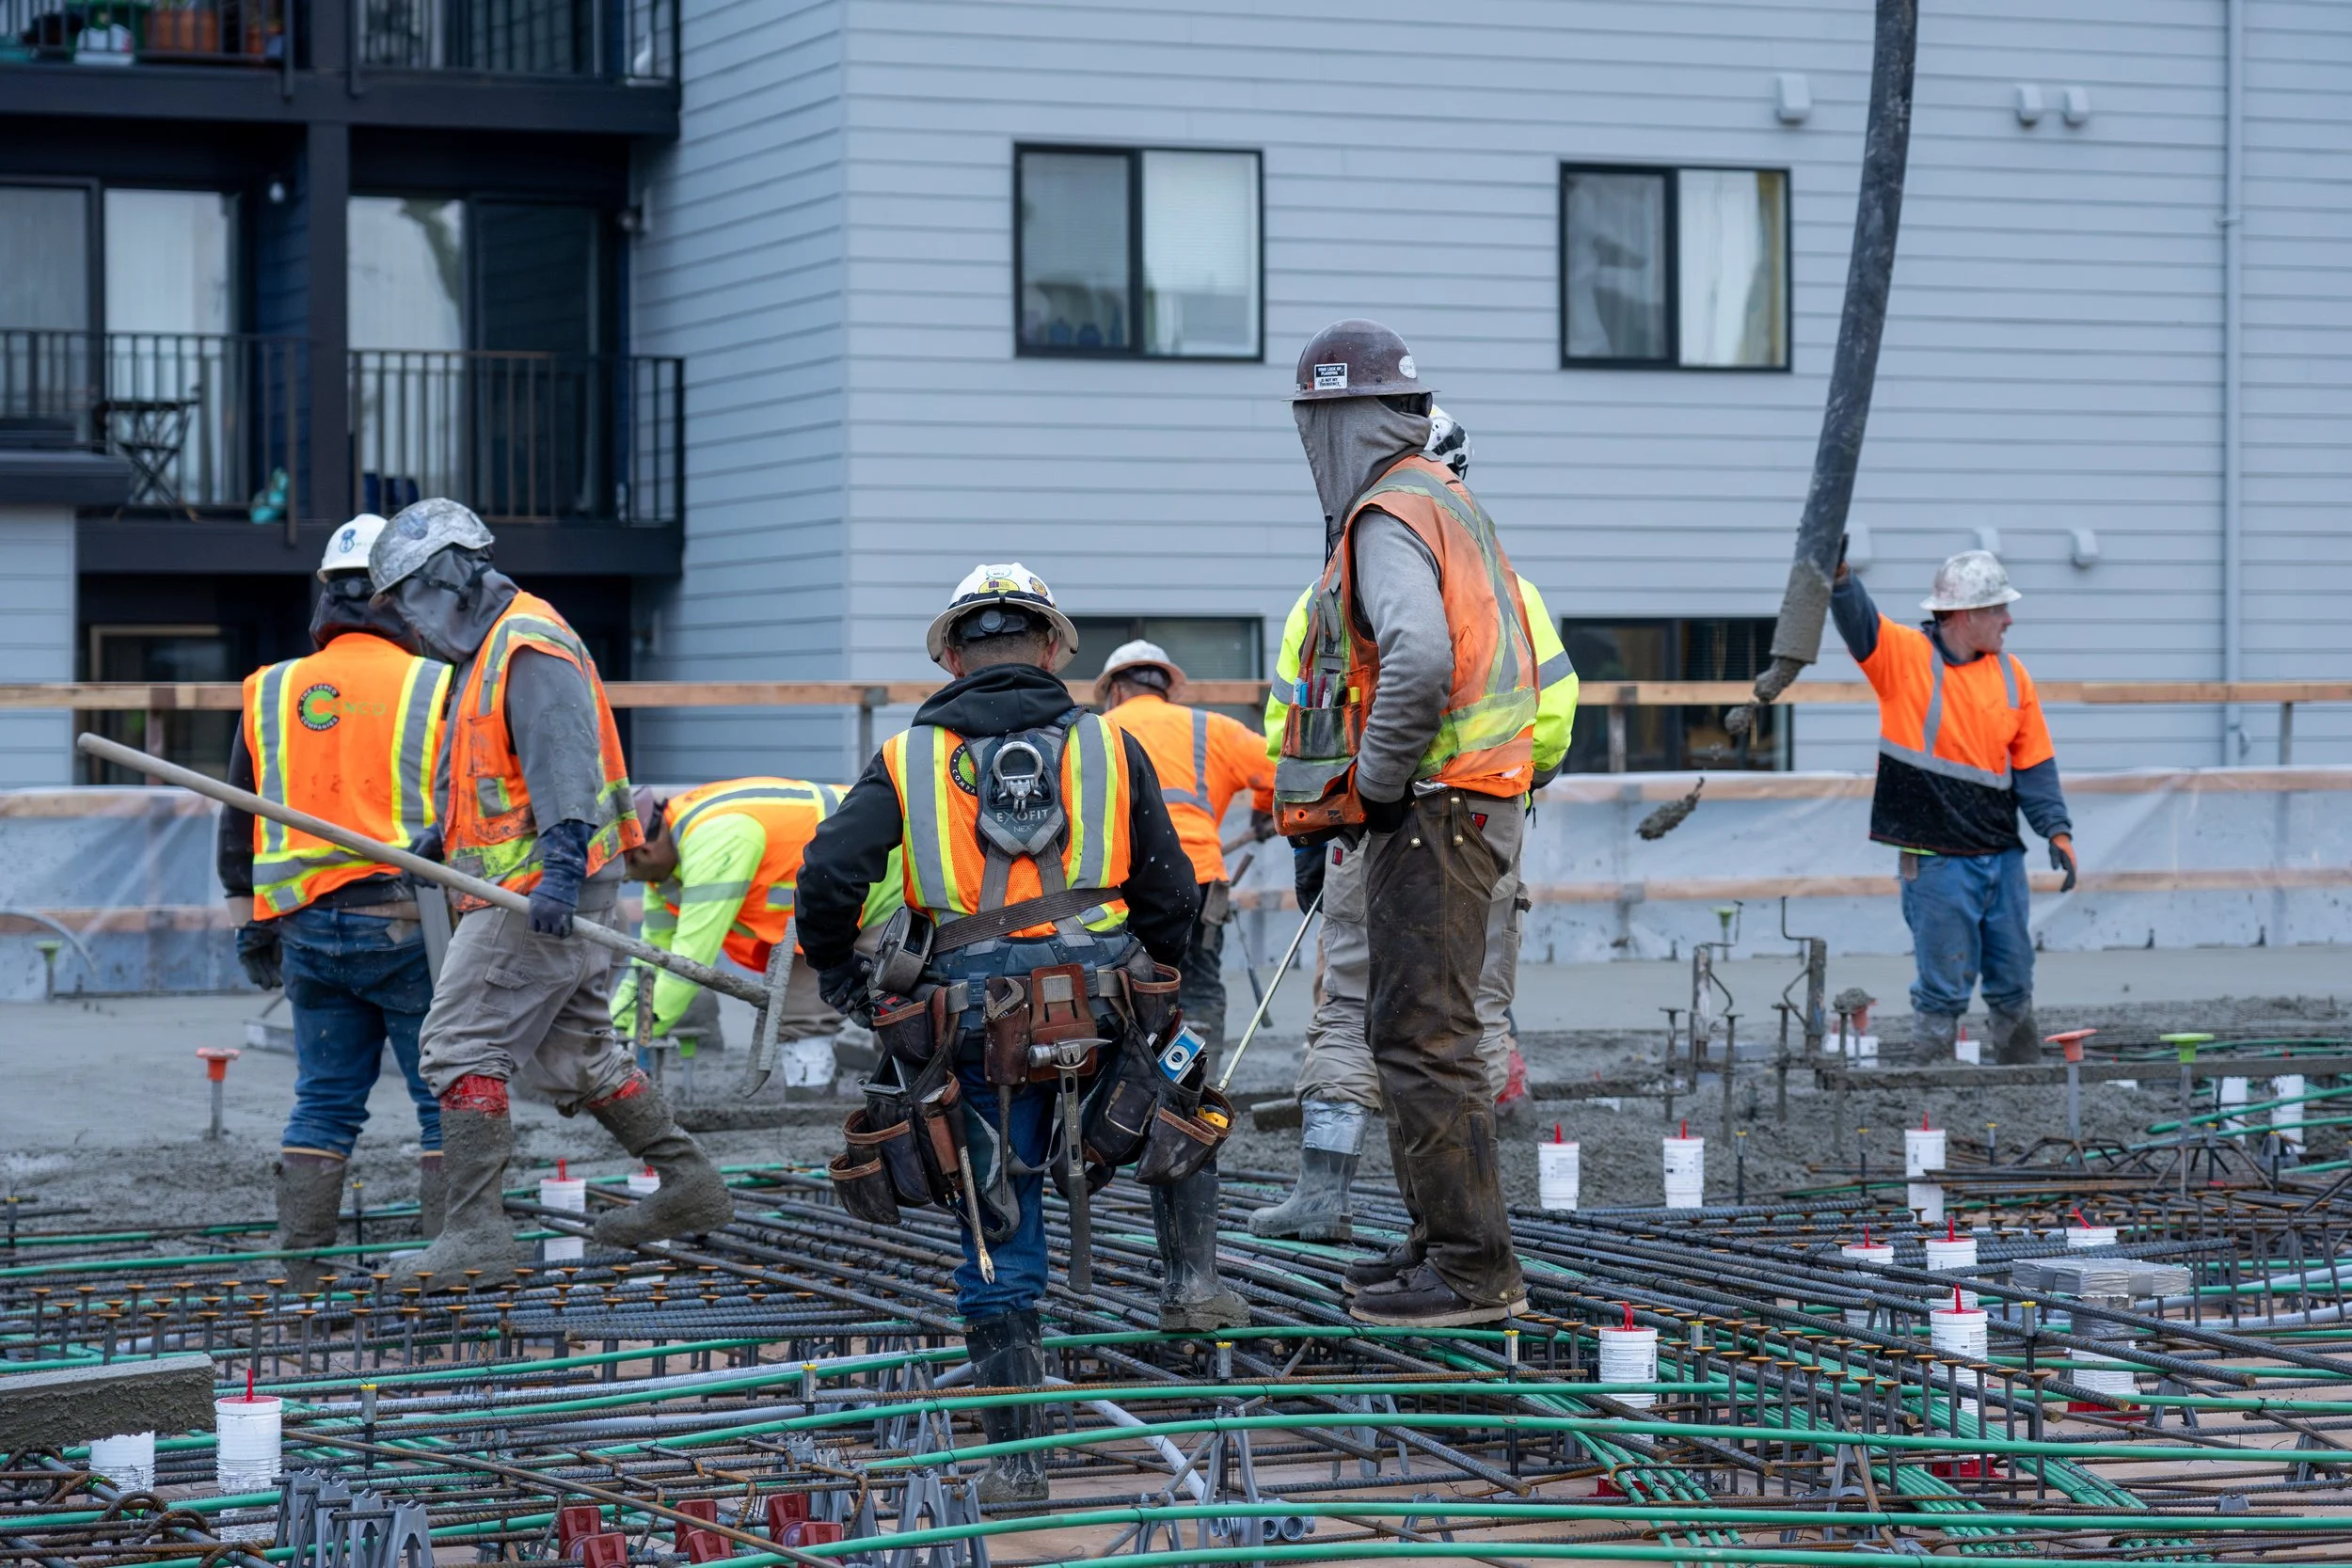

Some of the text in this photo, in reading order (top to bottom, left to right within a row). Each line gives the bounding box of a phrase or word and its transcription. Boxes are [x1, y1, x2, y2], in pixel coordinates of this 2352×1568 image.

[313, 684, 337, 696] CONCO
[300, 715, 338, 729] COMPANIES
[956, 745, 966, 754] TH
[952, 768, 976, 794] COMPA
